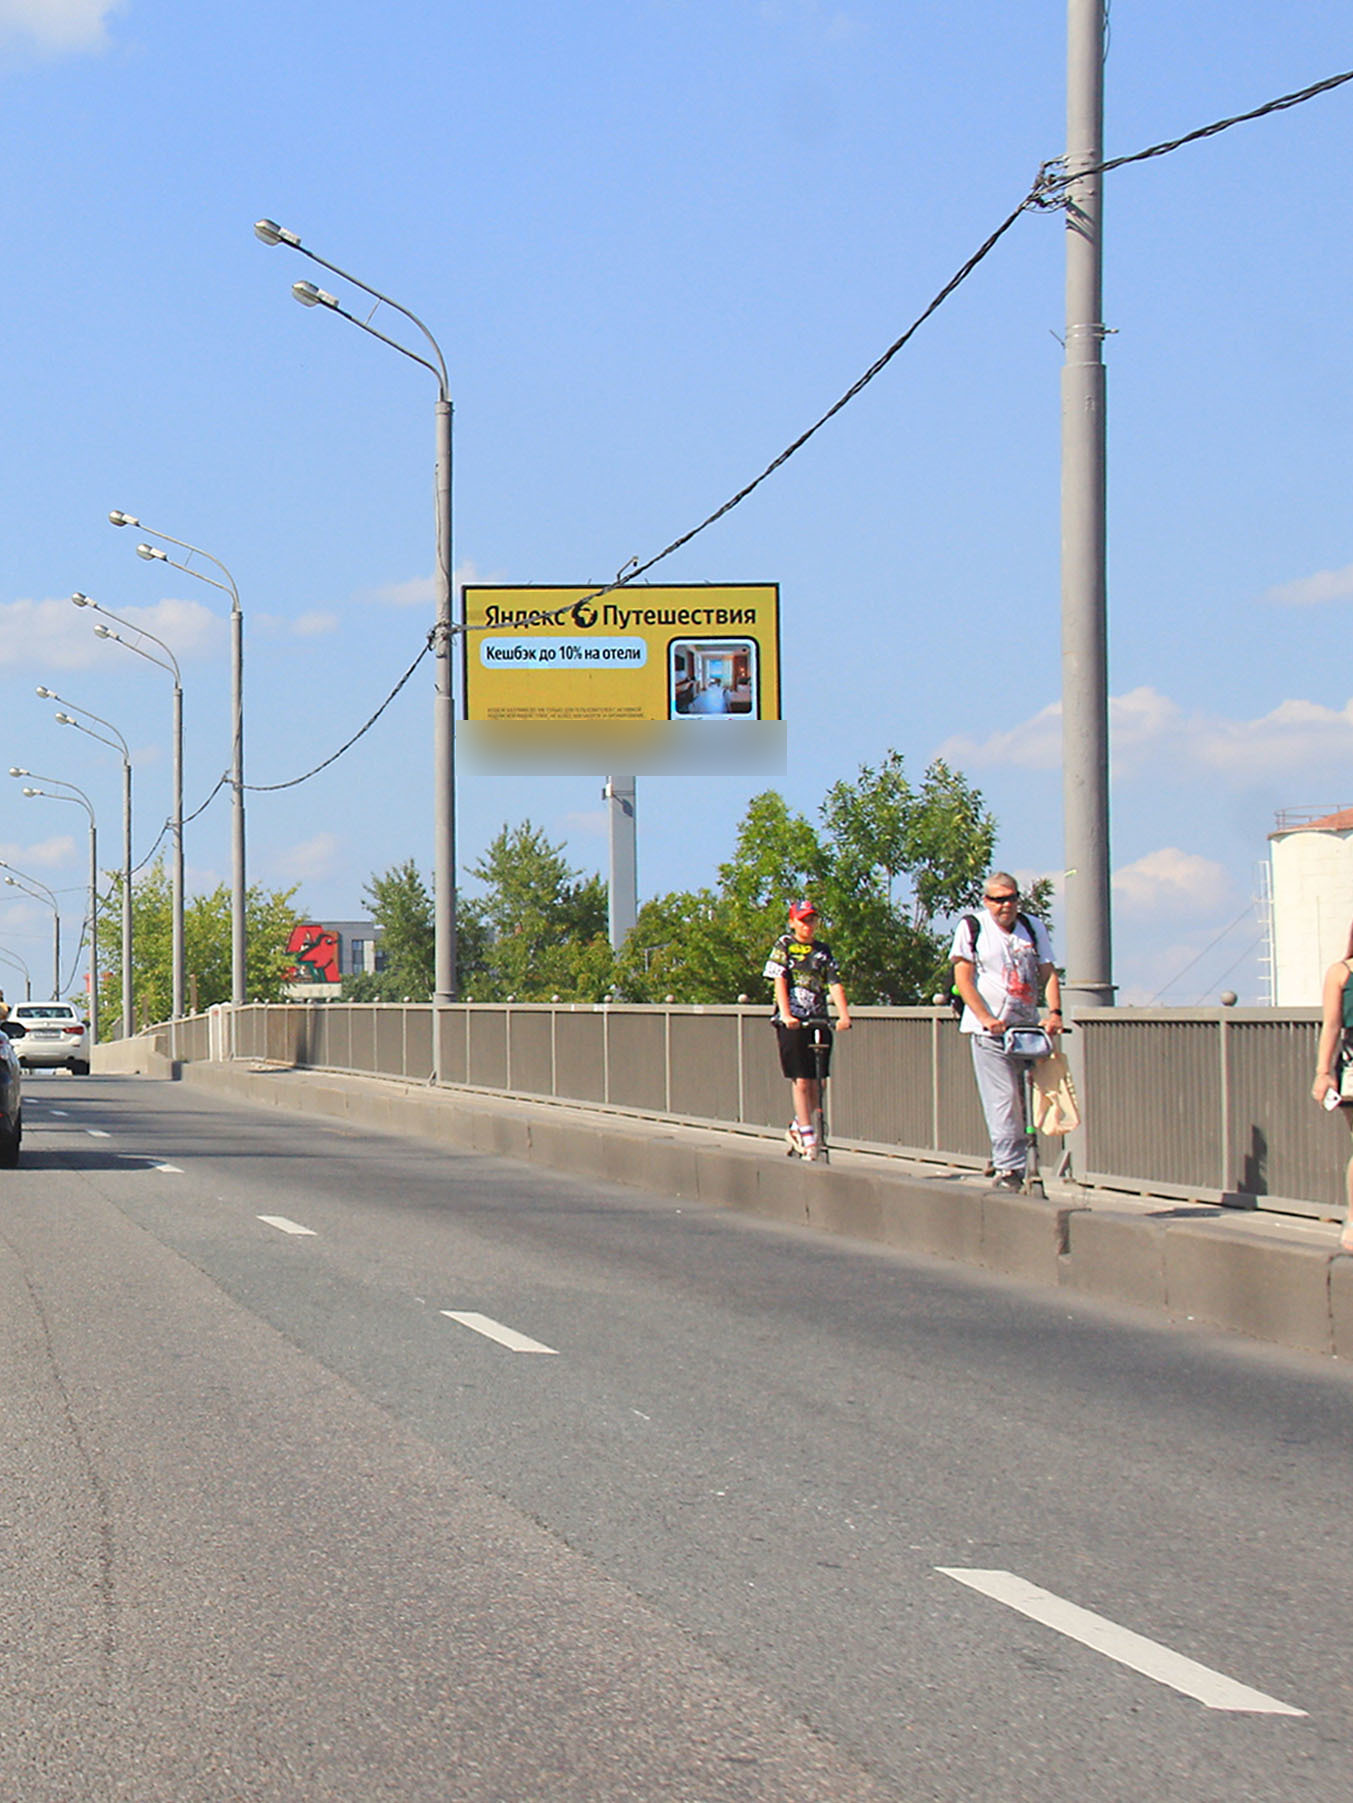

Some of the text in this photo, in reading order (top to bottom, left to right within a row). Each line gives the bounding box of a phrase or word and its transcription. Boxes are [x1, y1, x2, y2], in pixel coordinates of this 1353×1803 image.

[486, 604, 756, 630] Яндекс Путешествия
[486, 645, 641, 662] Кешбэк до 10% на отели
